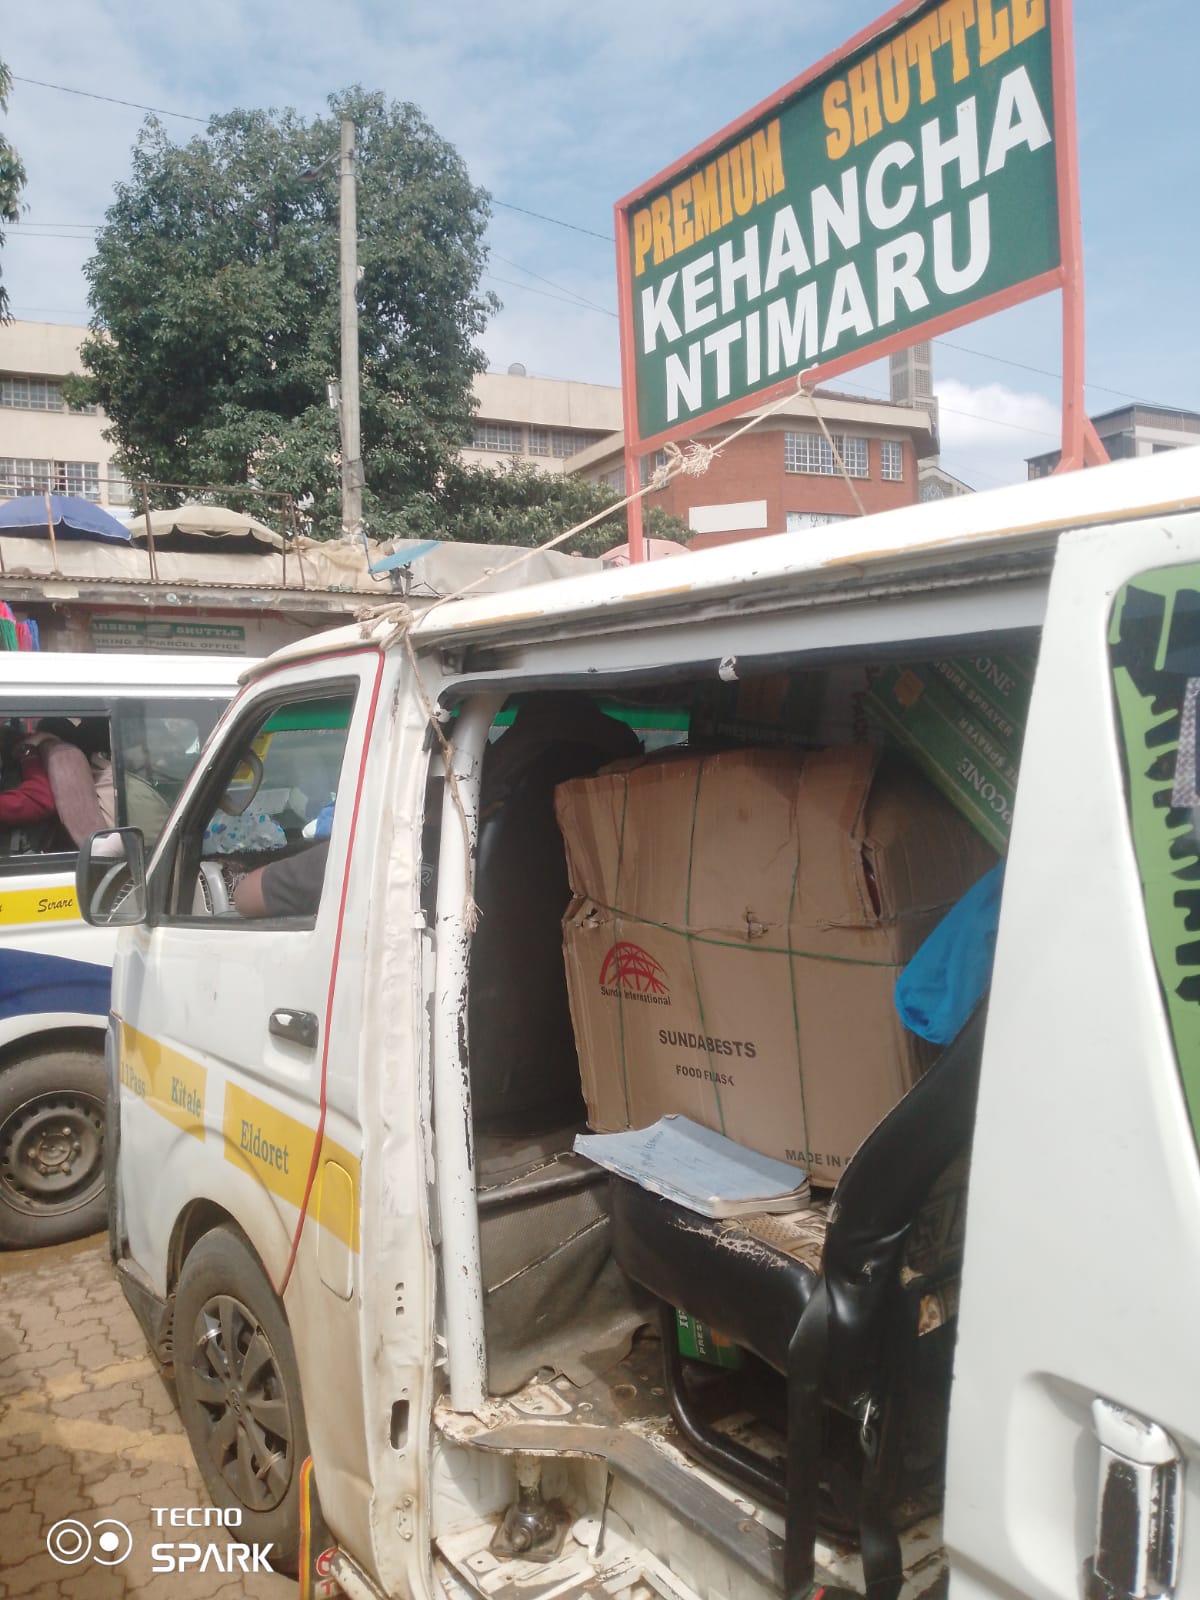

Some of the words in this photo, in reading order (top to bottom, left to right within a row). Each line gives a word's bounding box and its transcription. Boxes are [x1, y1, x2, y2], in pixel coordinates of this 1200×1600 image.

[633, 118, 786, 277] PREMIUM
[641, 65, 1052, 355] KEHANCHA
[664, 193, 991, 423] NTIMARU
[200, 641, 241, 650] OFFICE
[967, 688, 1014, 737] SPRAYER
[658, 1029, 757, 1059] SUNDABESTS
[675, 1064, 703, 1081] FOOD
[171, 1076, 202, 1118] Kitale
[240, 1118, 290, 1176] Eldoret
[785, 1148, 824, 1167] MADE
[825, 1154, 841, 1168] IN
